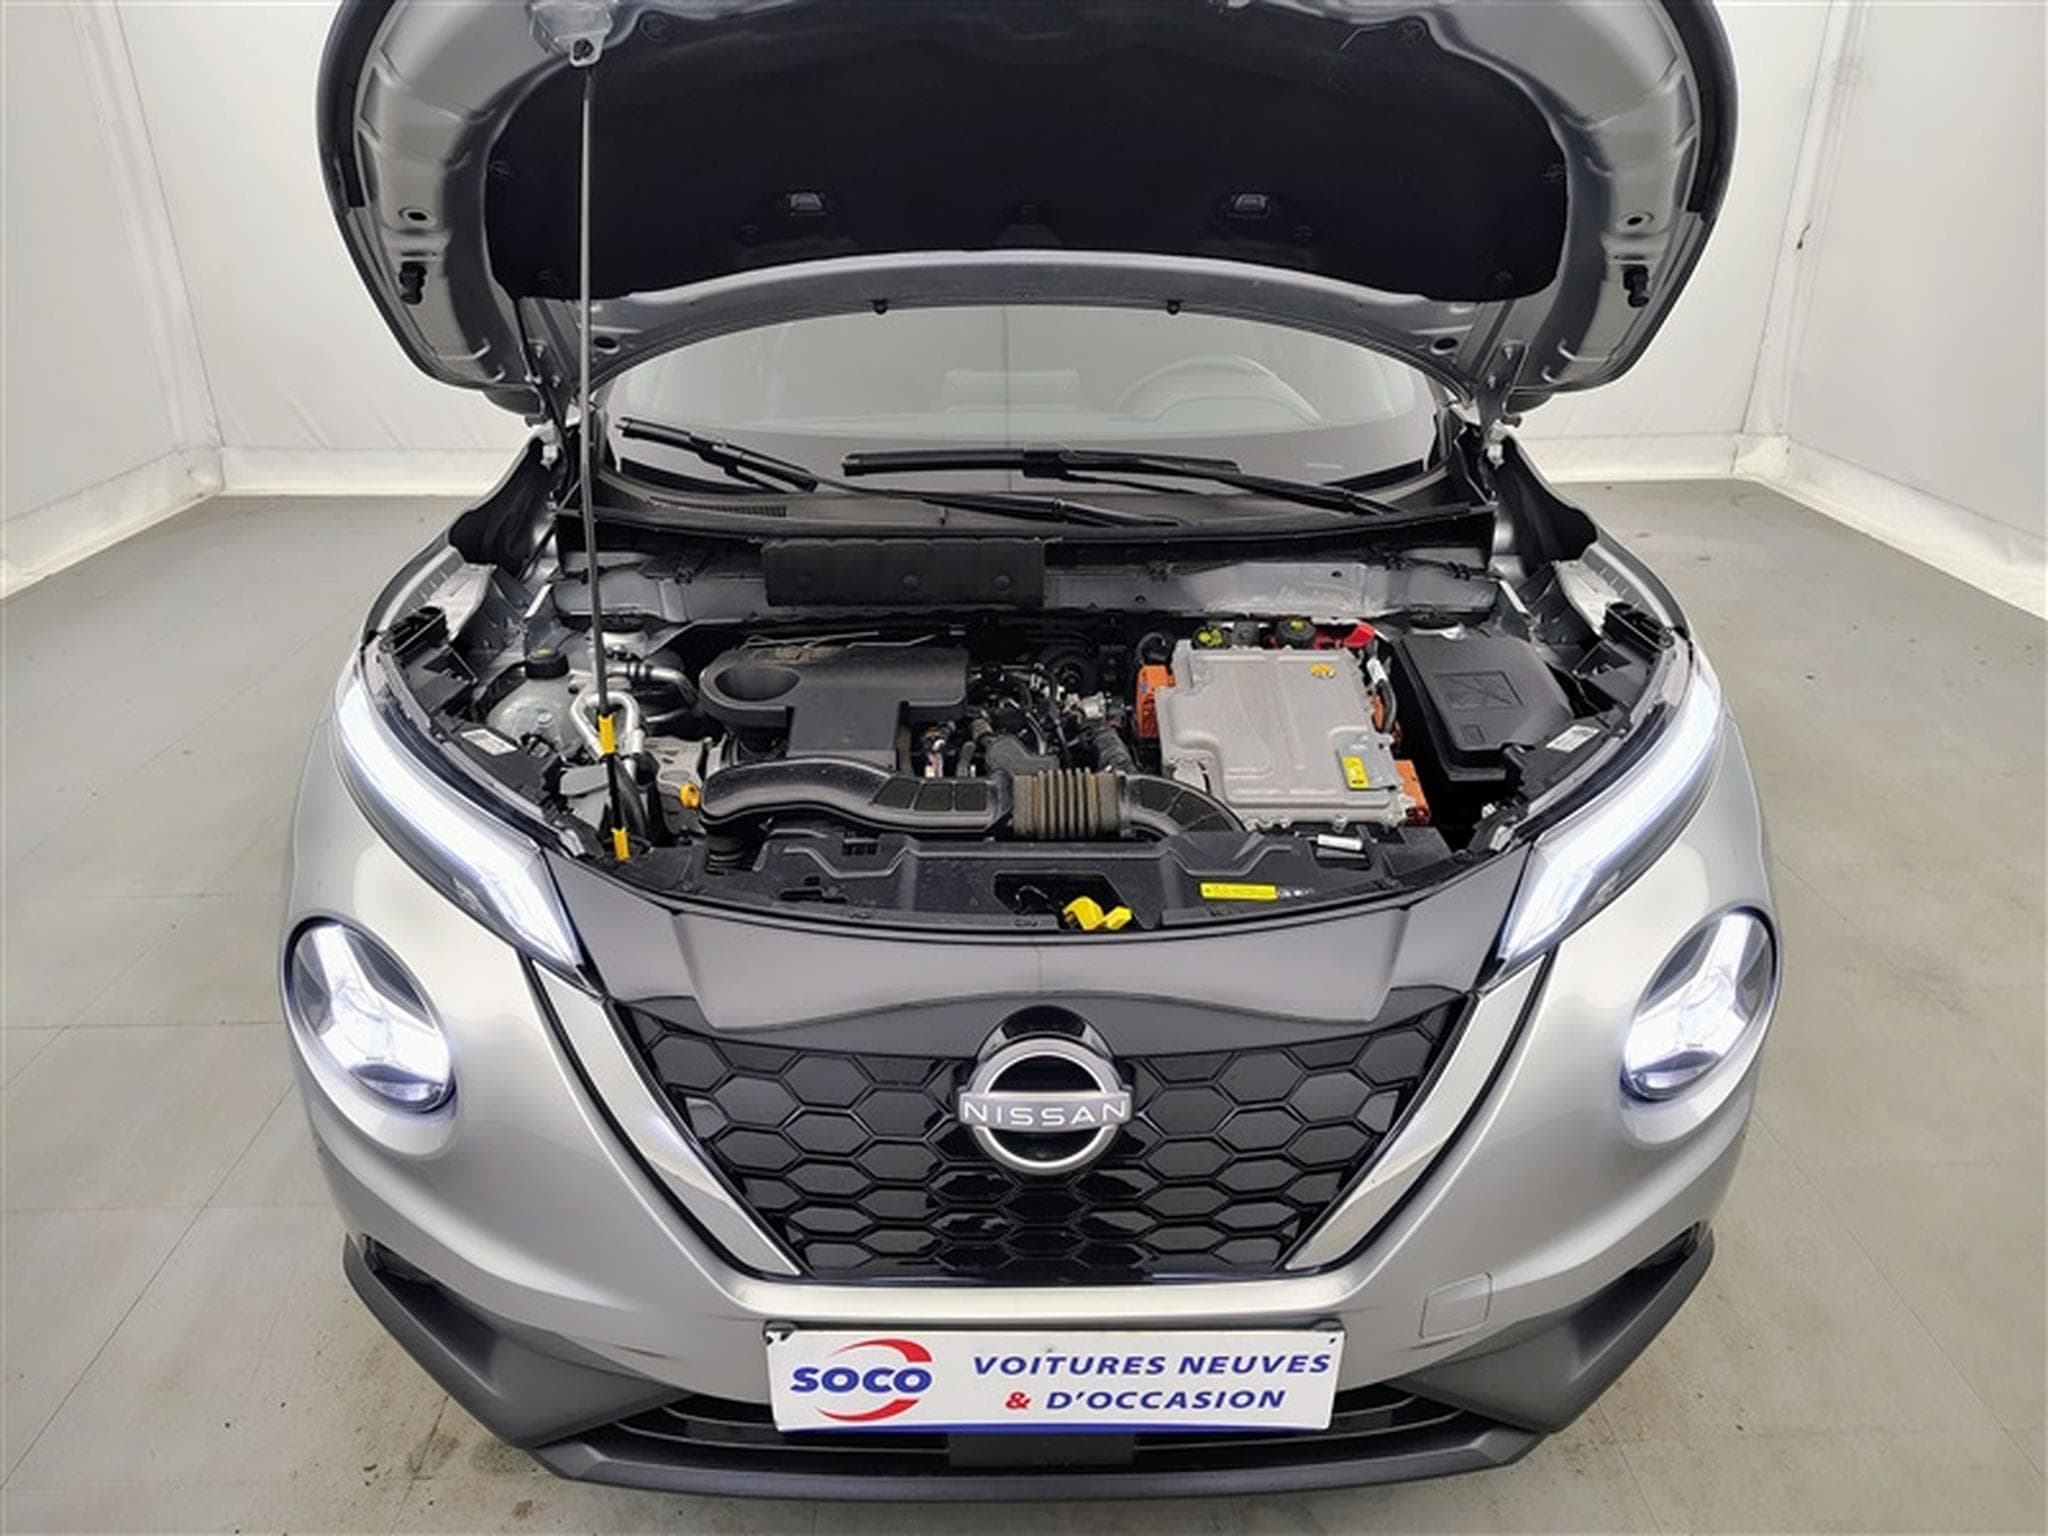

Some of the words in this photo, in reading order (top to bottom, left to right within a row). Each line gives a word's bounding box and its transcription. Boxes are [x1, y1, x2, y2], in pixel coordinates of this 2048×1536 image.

[963, 1101, 1126, 1127] NISSAN
[973, 1355, 1167, 1376] VOITURES
[1177, 1354, 1332, 1374] NEUVES
[791, 1366, 933, 1394] SOCO
[1004, 1391, 1032, 1411] &
